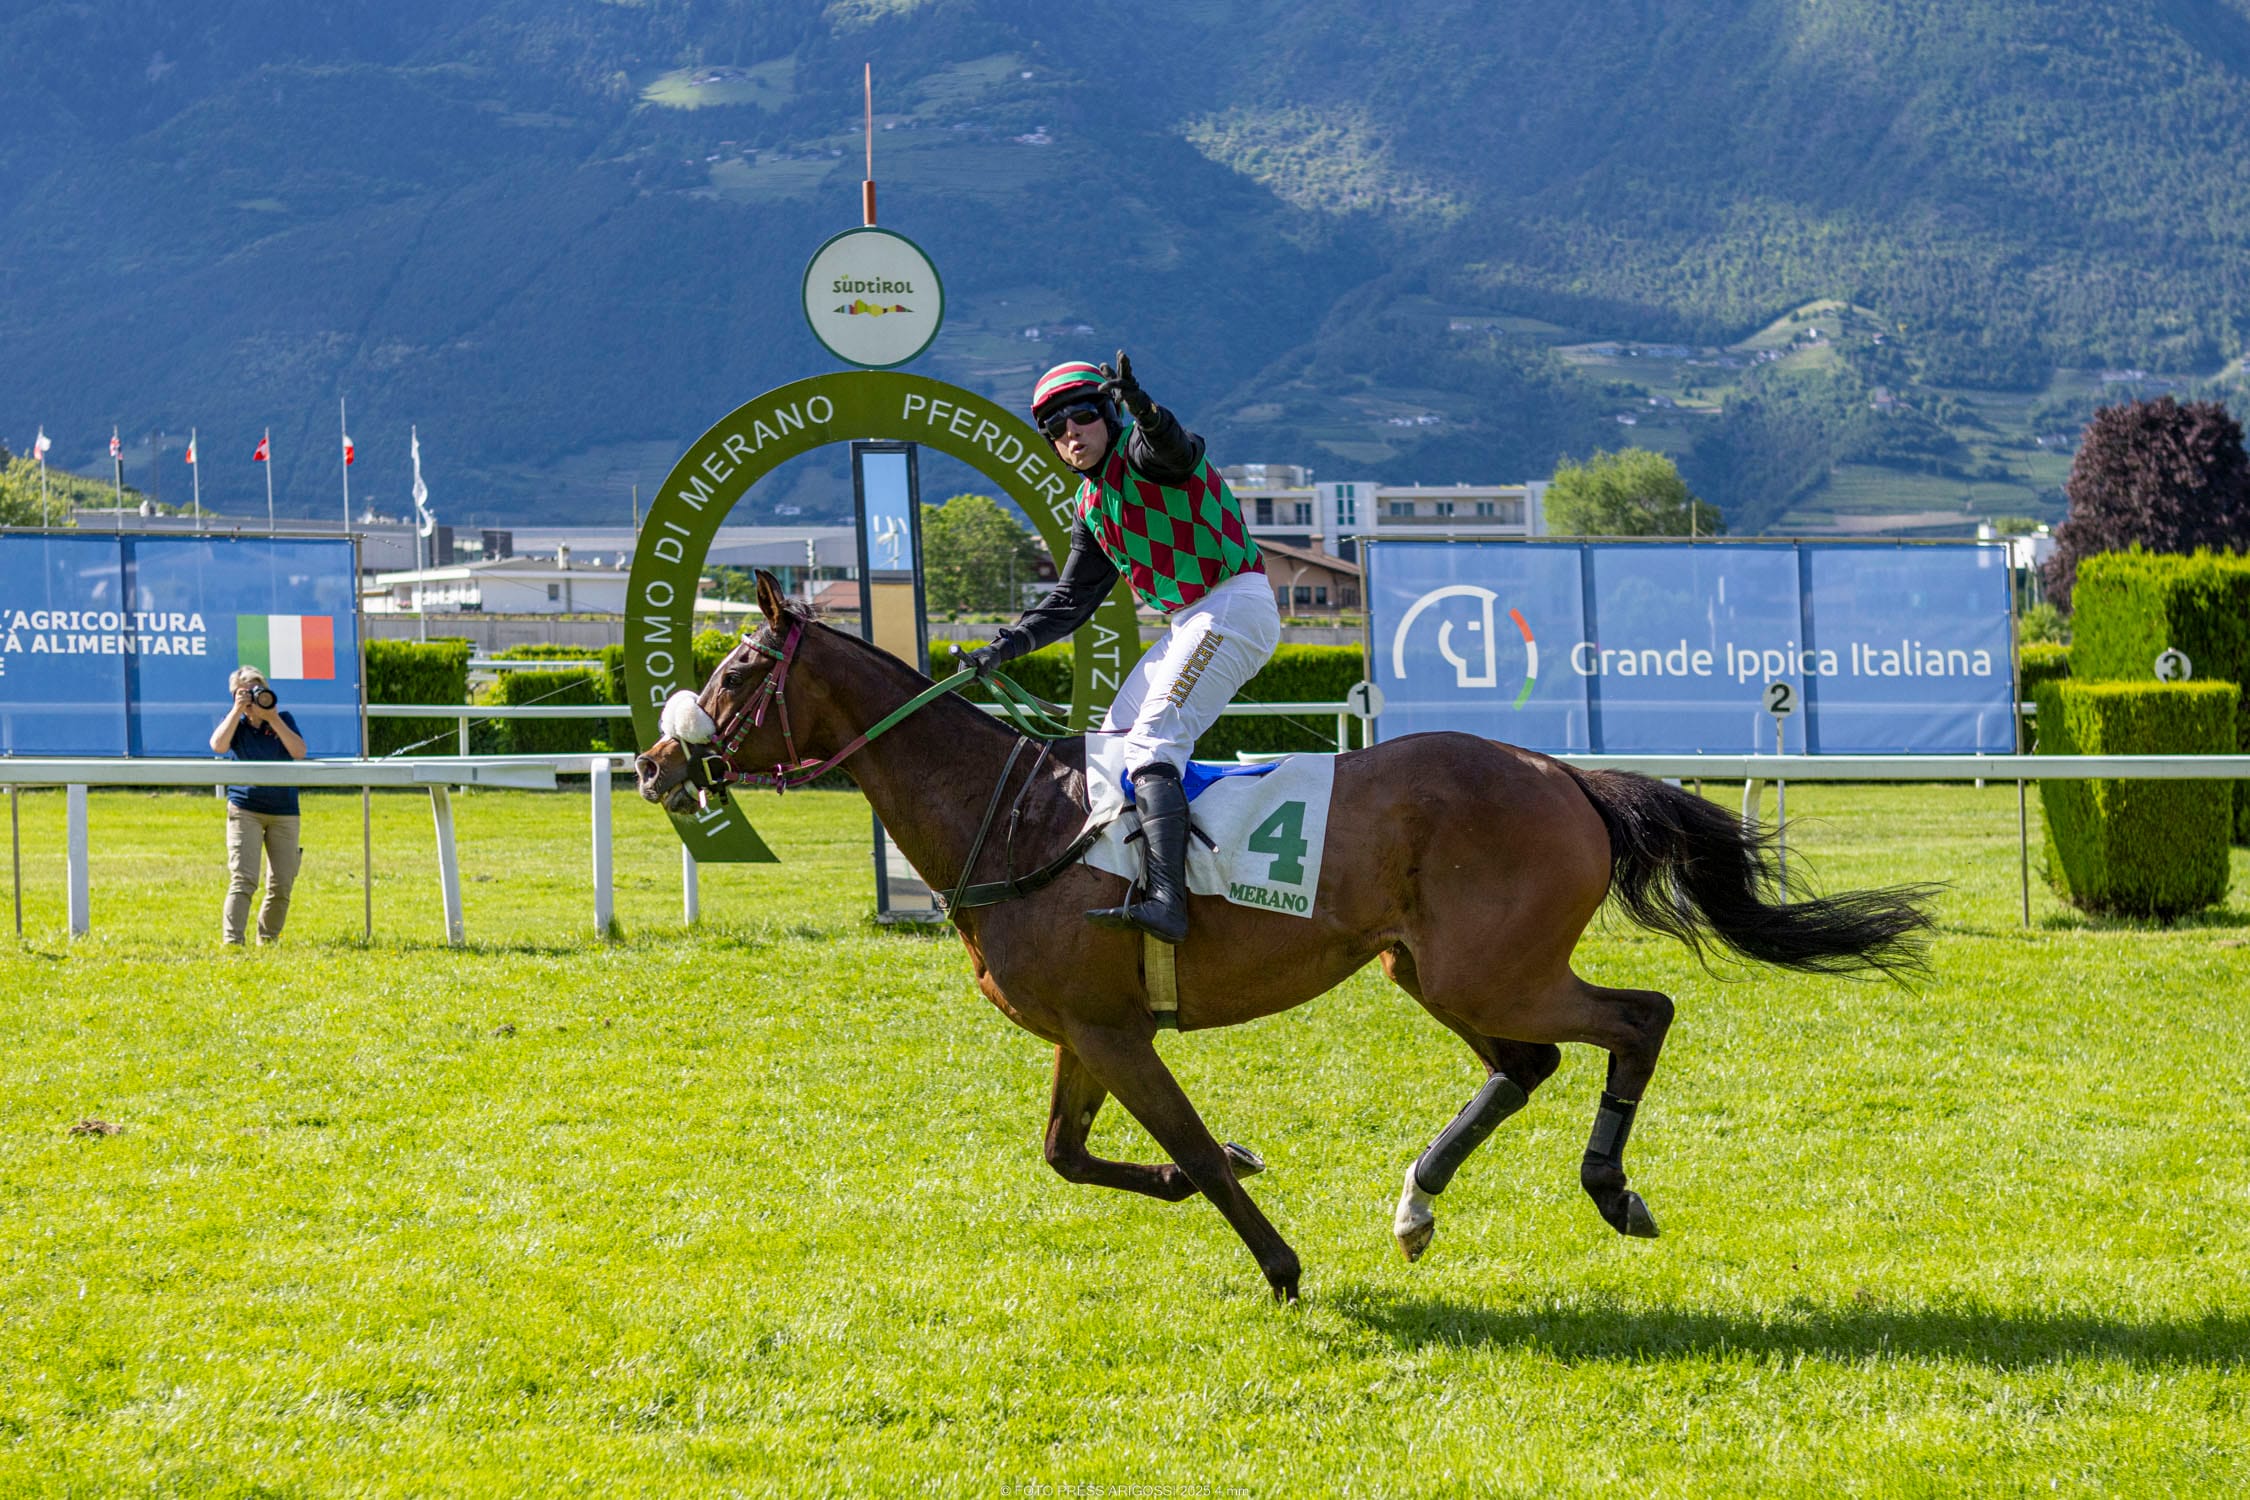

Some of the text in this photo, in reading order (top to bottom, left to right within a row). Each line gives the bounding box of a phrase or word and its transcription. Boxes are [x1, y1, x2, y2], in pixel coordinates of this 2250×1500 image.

[653, 521, 691, 564] DI
[678, 395, 834, 512] MERANO
[31, 634, 207, 655] ALIMENTARE
[1570, 639, 1992, 684] Grande Ippica Italiana
[2162, 654, 2182, 683] 3
[1356, 685, 1370, 714] 1
[1770, 683, 1790, 712] 2
[1248, 801, 1308, 885] 4
[1229, 882, 1309, 912] MERANO
